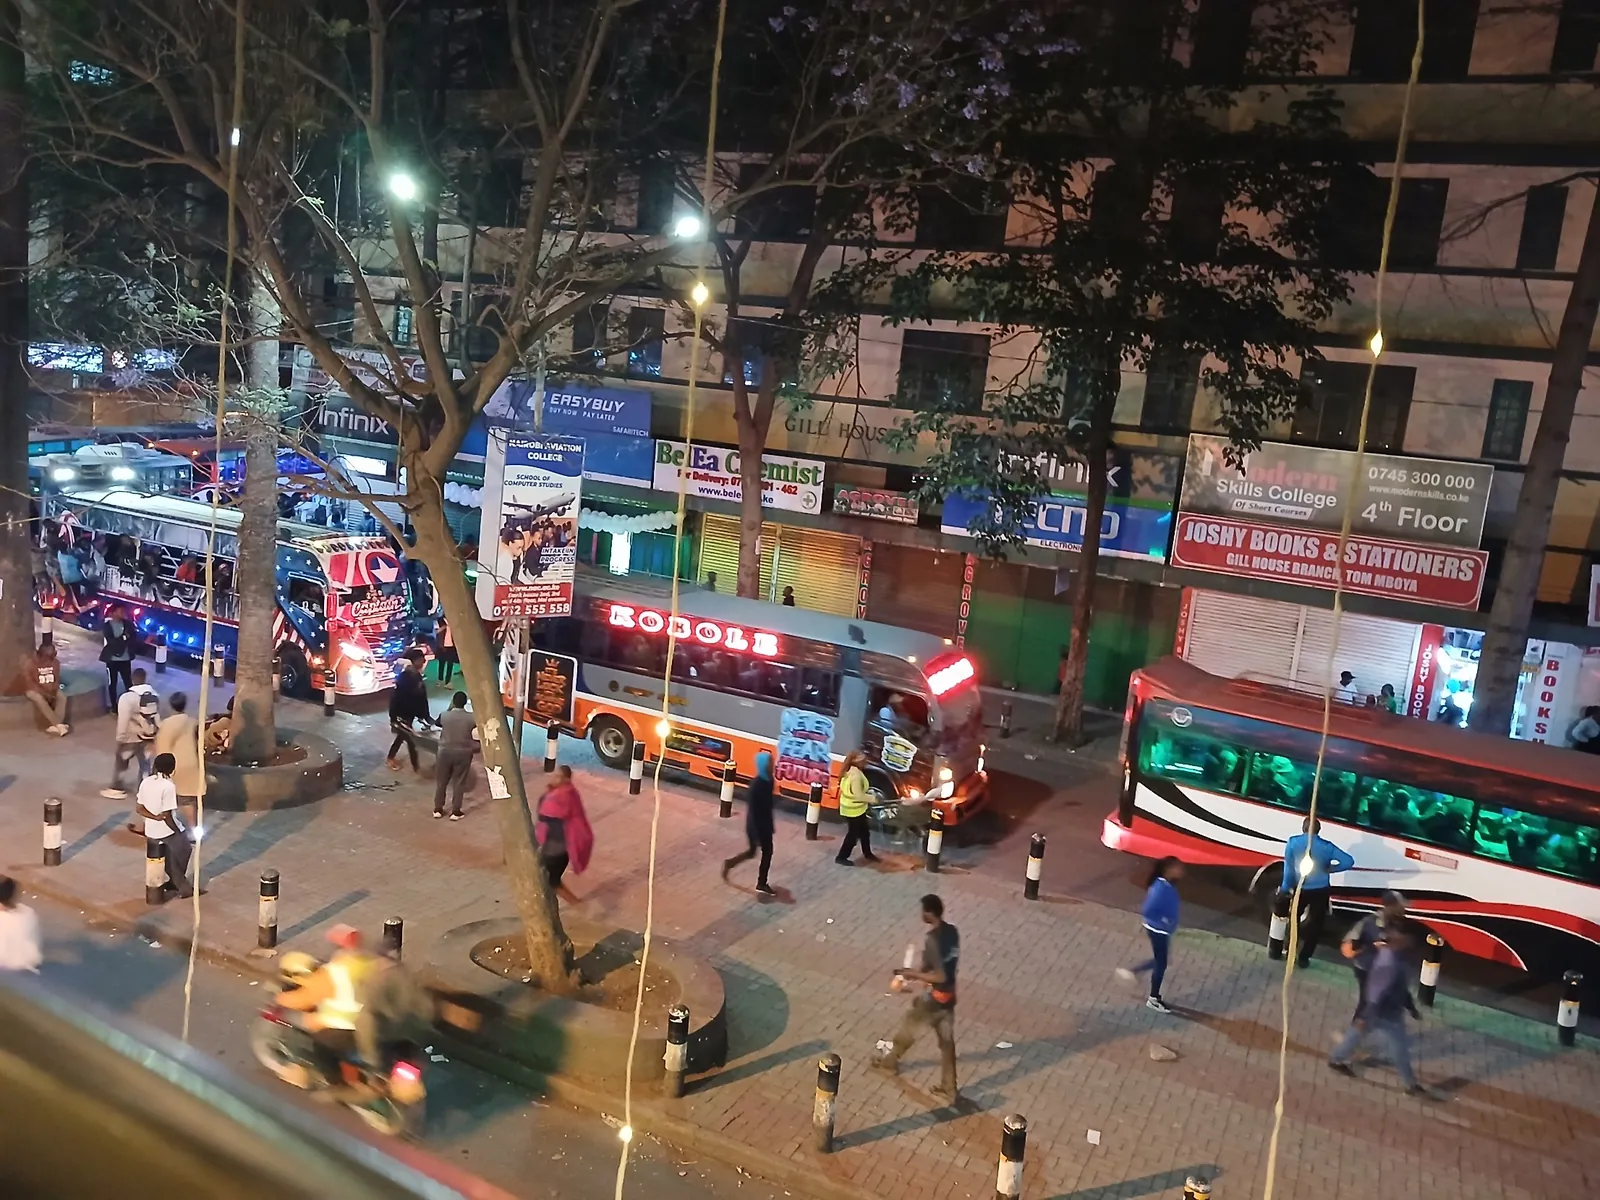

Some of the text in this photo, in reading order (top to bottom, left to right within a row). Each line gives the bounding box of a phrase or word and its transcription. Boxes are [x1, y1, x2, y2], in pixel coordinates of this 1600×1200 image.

[550, 393, 625, 413] EASYBUY
[318, 404, 389, 435] Infinix
[563, 408, 578, 416] NOW
[583, 411, 595, 419] PAY
[596, 413, 616, 421] LATER
[612, 426, 649, 437] SAFARITECH
[839, 422, 890, 444] HOUS
[509, 439, 582, 453] NAIROBI AVIATION
[527, 452, 563, 462] COLLEGE
[516, 473, 541, 481] SCHOOL
[725, 452, 823, 487] Cemist
[1368, 466, 1476, 490] 0745 300 000
[503, 479, 563, 489] COMPUTER STUDIES
[692, 472, 729, 487] Delivery:
[781, 484, 798, 496] 462
[1216, 479, 1337, 509] Skills College
[1368, 484, 1470, 504] www.modernskills.co.ke
[1235, 501, 1308, 517] Of Short Courses
[1397, 506, 1469, 533] Floor
[1184, 521, 1475, 582] JOSHY BOOKS & STATIONERS
[1226, 552, 1418, 593] GILL HOUSE BRANCH TOM MBOYA
[524, 604, 546, 615] 555
[549, 603, 570, 614] 558
[1419, 643, 1433, 683] JOSHY
